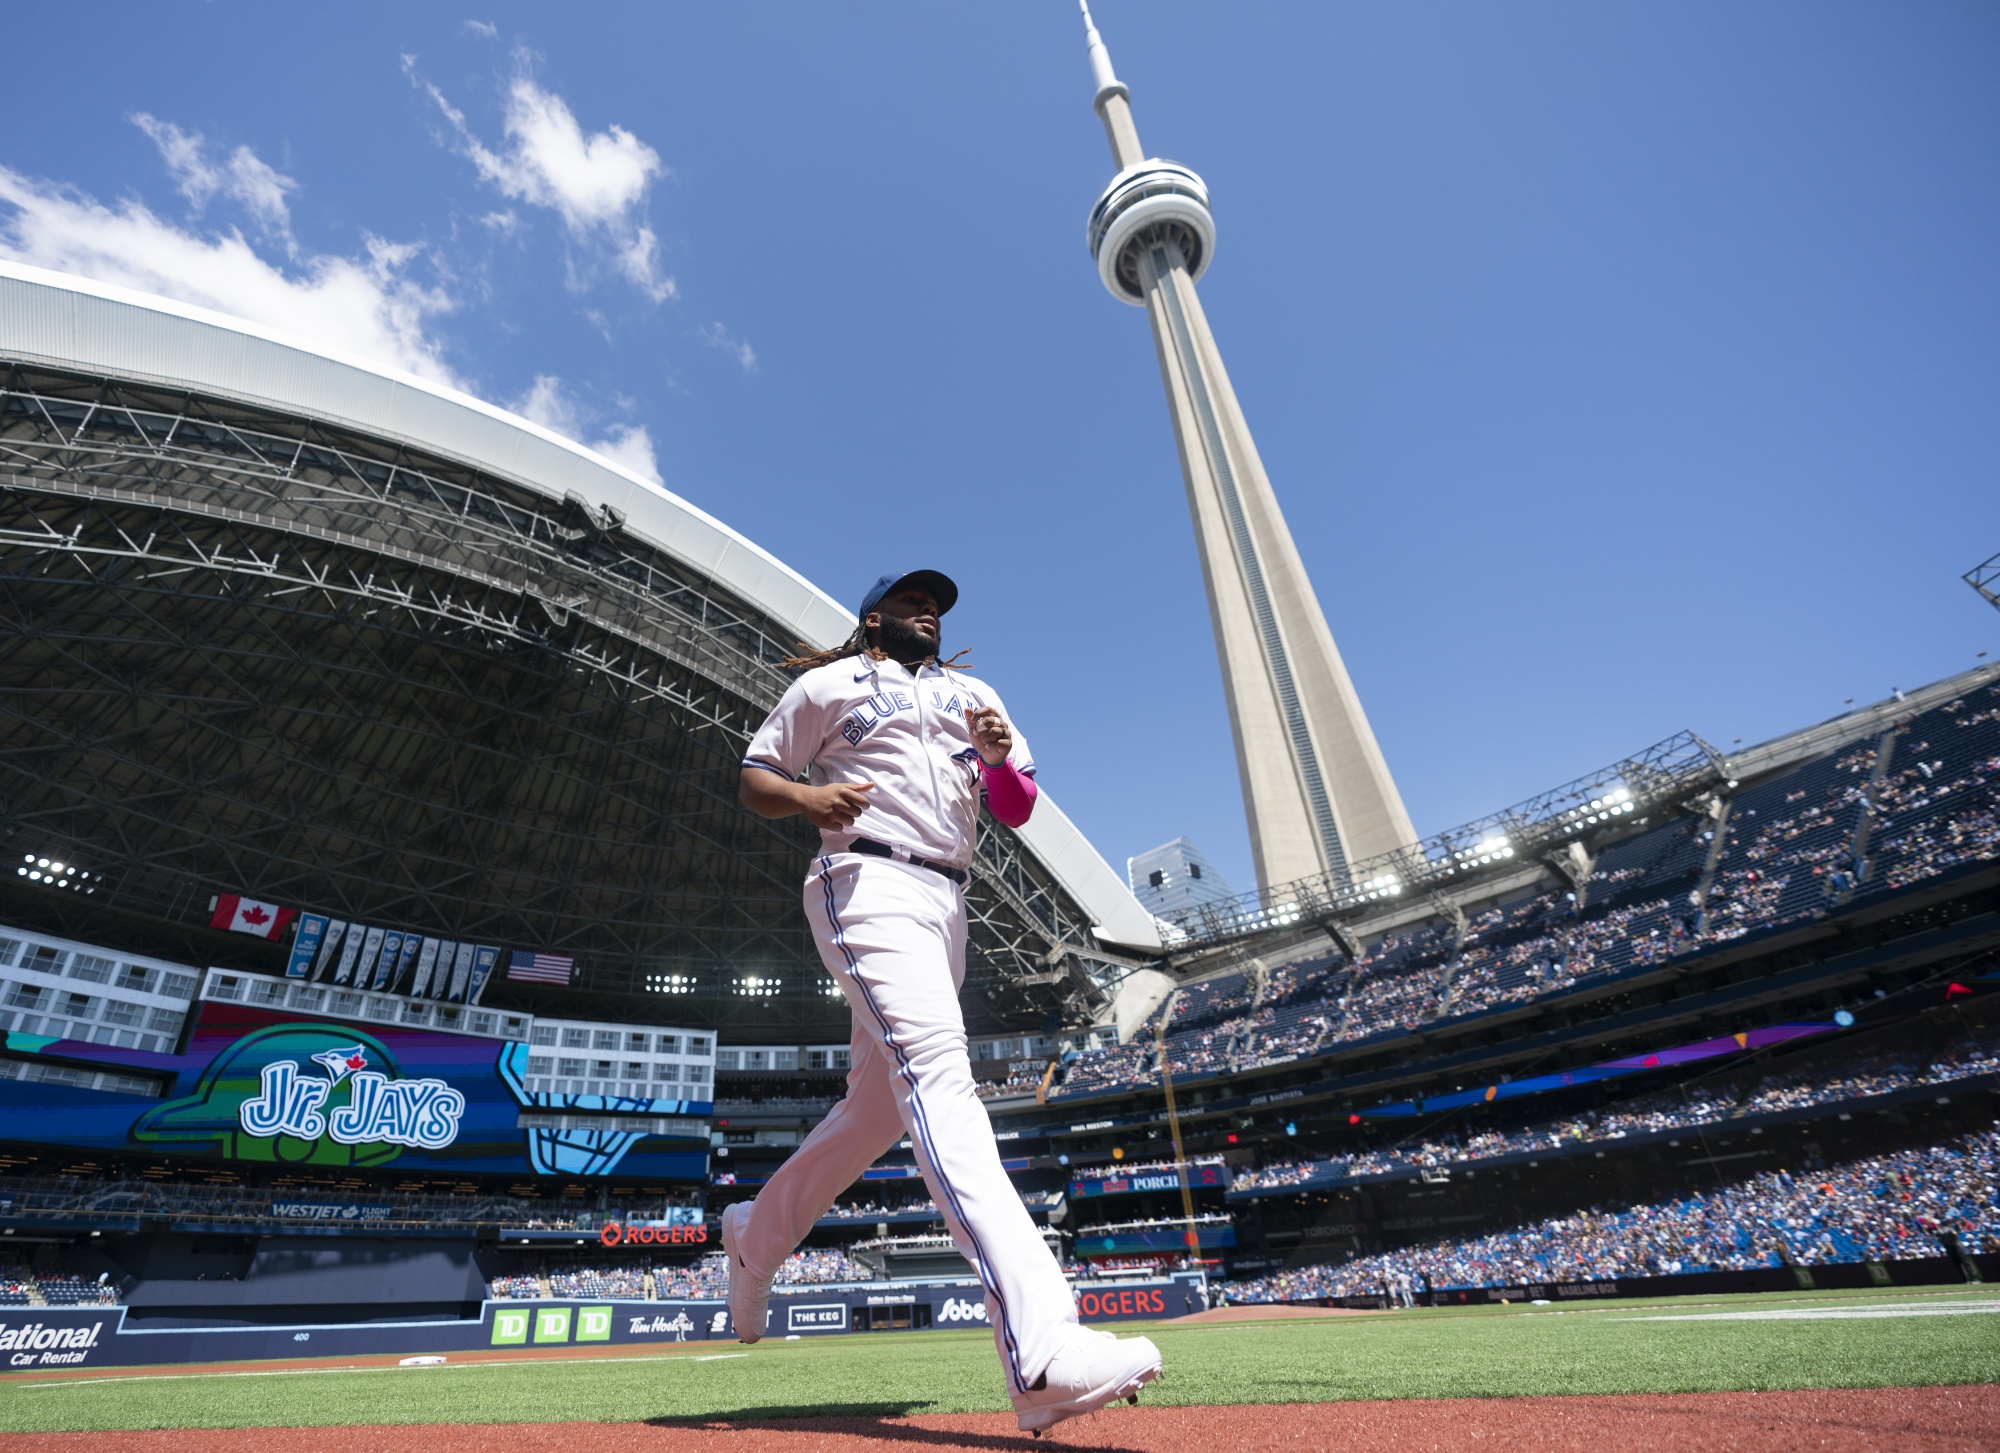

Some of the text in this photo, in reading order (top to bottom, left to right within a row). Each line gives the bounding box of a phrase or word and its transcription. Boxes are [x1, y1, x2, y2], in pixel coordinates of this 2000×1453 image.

[842, 691, 978, 748] BLUE JA
[471, 970, 487, 986] 3
[1008, 1059, 1048, 1073] ROOFTOP
[328, 1072, 465, 1149] JAYS
[1133, 1175, 1179, 1191] PORCH
[272, 1204, 391, 1220] WESTJET FLIGHT
[626, 1224, 708, 1244] ROGERS
[1303, 1216, 1436, 1238] TORONTO BLUE JAYS
[1529, 1286, 1545, 1298] BET
[1557, 1284, 1597, 1297] BASELINE
[1598, 1283, 1618, 1295] BOX
[795, 1311, 839, 1323] THE KEG
[937, 1297, 988, 1323] Sobe
[498, 1315, 525, 1337] TD
[540, 1314, 566, 1336] TD
[582, 1312, 608, 1334] TD
[629, 1317, 650, 1334] Tim
[293, 1333, 310, 1342] 400
[10, 1349, 88, 1366] Car Rental
